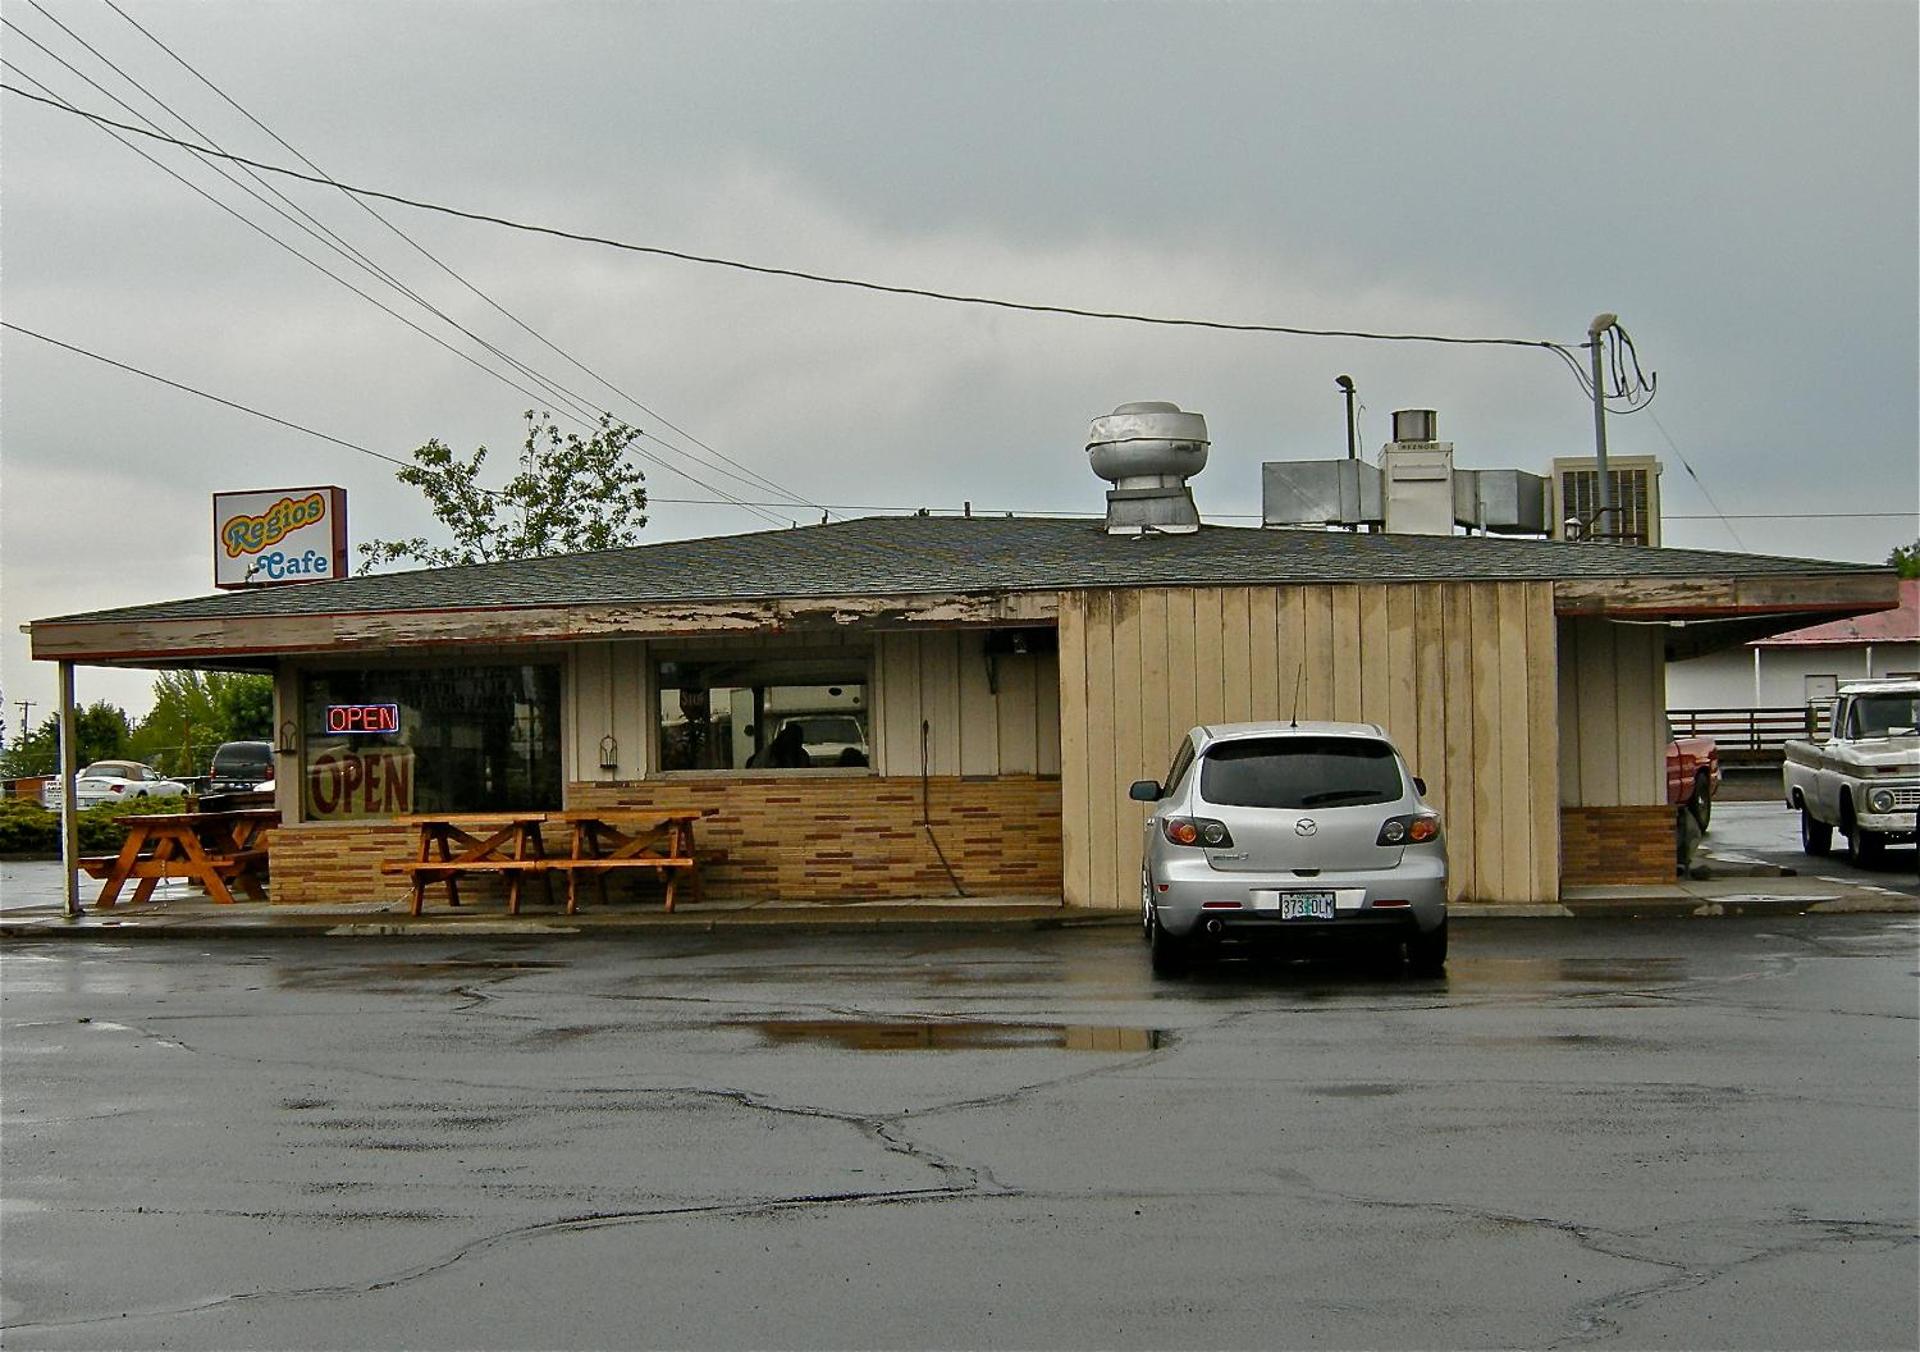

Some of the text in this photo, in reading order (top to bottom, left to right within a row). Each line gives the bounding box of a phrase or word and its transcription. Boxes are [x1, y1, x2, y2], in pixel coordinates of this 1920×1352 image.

[226, 497, 321, 552] Regios
[257, 550, 327, 579] Cafe
[330, 707, 395, 731] OPEN
[311, 754, 409, 814] OPEN
[1283, 899, 1304, 914] 373
